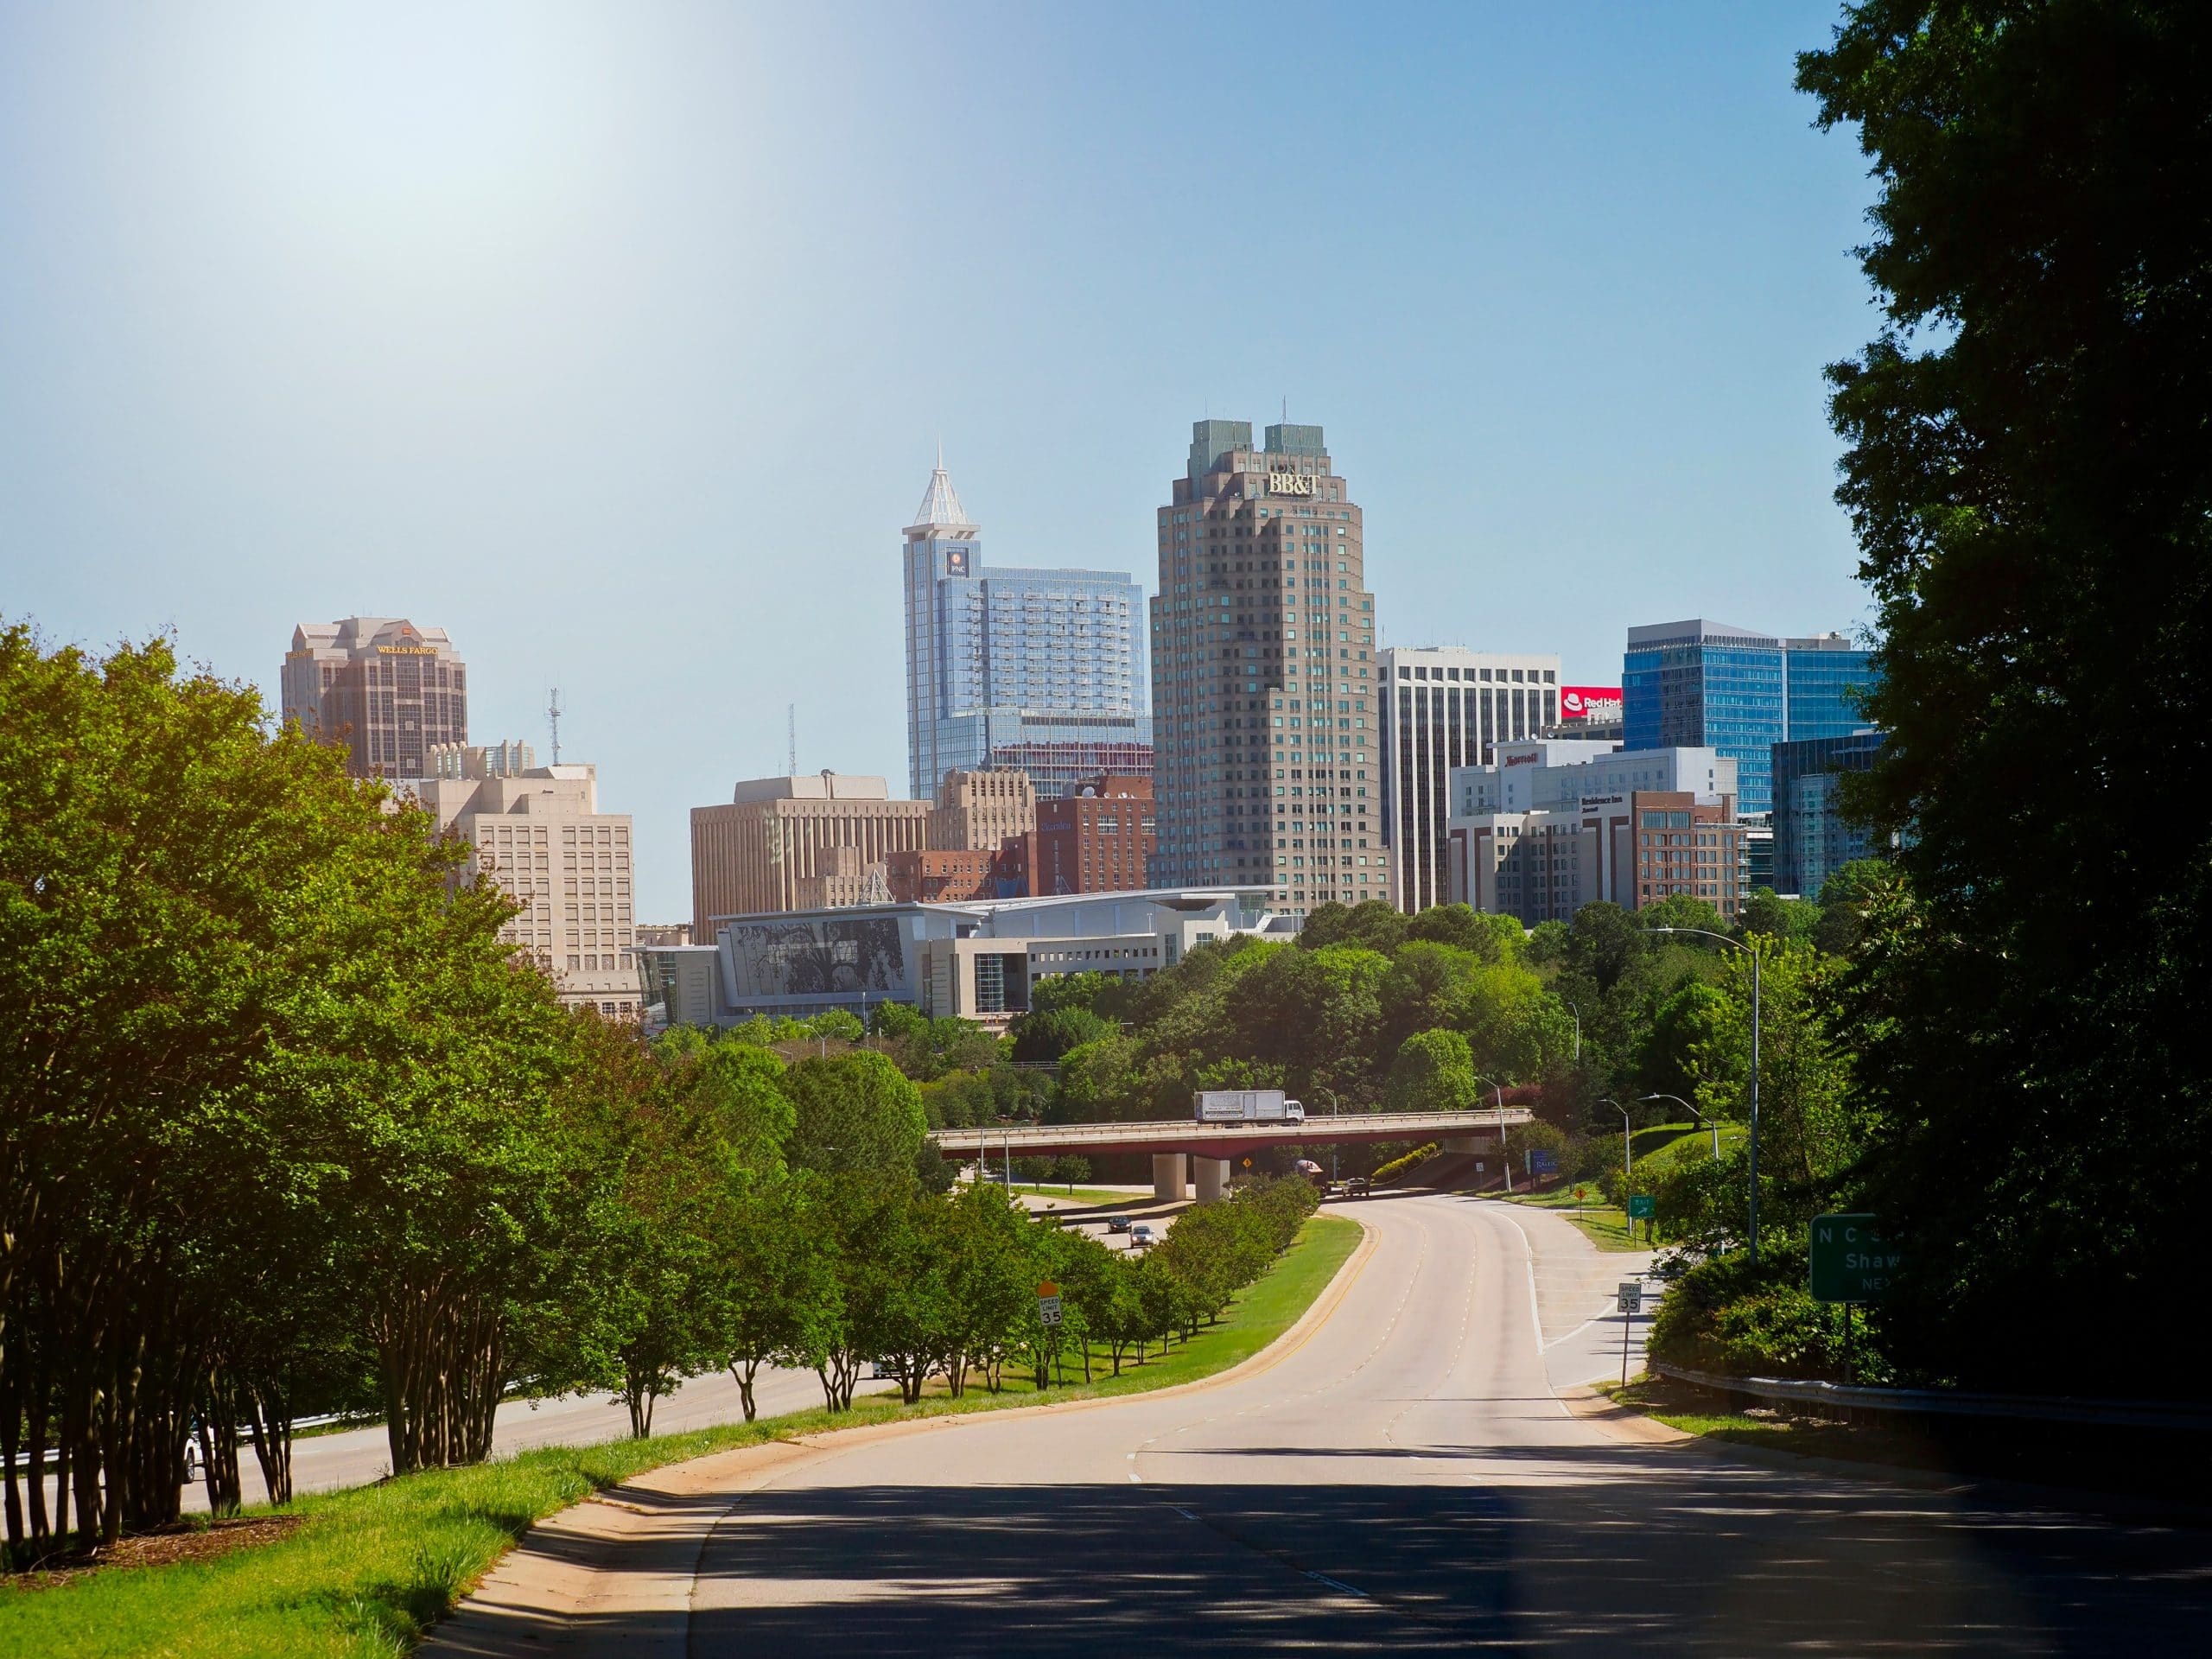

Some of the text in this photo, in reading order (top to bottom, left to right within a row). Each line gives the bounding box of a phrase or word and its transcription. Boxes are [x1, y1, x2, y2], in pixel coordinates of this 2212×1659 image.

[1268, 473, 1320, 494] BB&T
[378, 645, 408, 655] WELLS
[1584, 697, 1621, 708] Red Hat
[1504, 753, 1538, 768] Marriott
[1581, 795, 1623, 805] Residence Inn
[1846, 1253, 1900, 1268] Shaw
[1620, 1299, 1638, 1309] 35
[1043, 1311, 1061, 1324] 35
